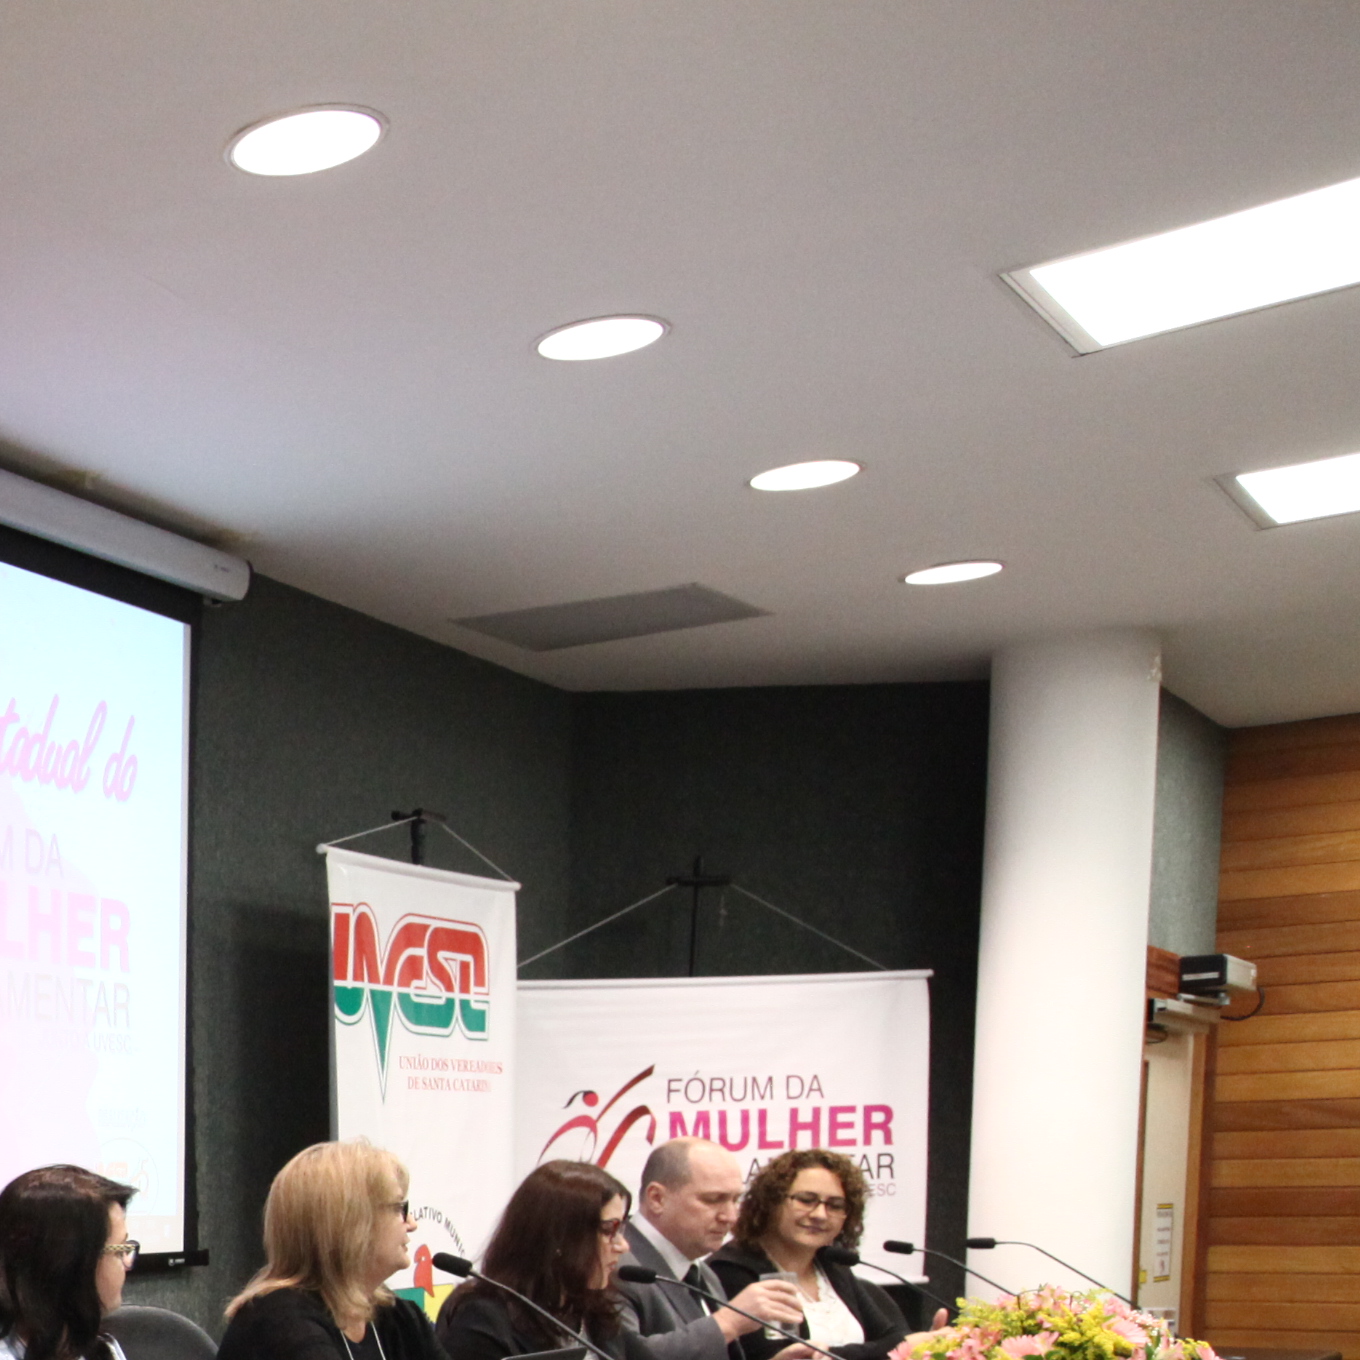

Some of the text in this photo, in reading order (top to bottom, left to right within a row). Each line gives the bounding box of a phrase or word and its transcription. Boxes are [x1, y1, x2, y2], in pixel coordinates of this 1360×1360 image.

[103, 715, 138, 802] do
[24, 828, 64, 878] DA
[398, 1053, 429, 1070] UNIÃO
[431, 1057, 449, 1072] DOS
[407, 1076, 421, 1090] DE
[422, 1077, 452, 1092] SANTA
[667, 1069, 825, 1104] FÓRUM DA
[669, 1104, 894, 1152] MULHER
